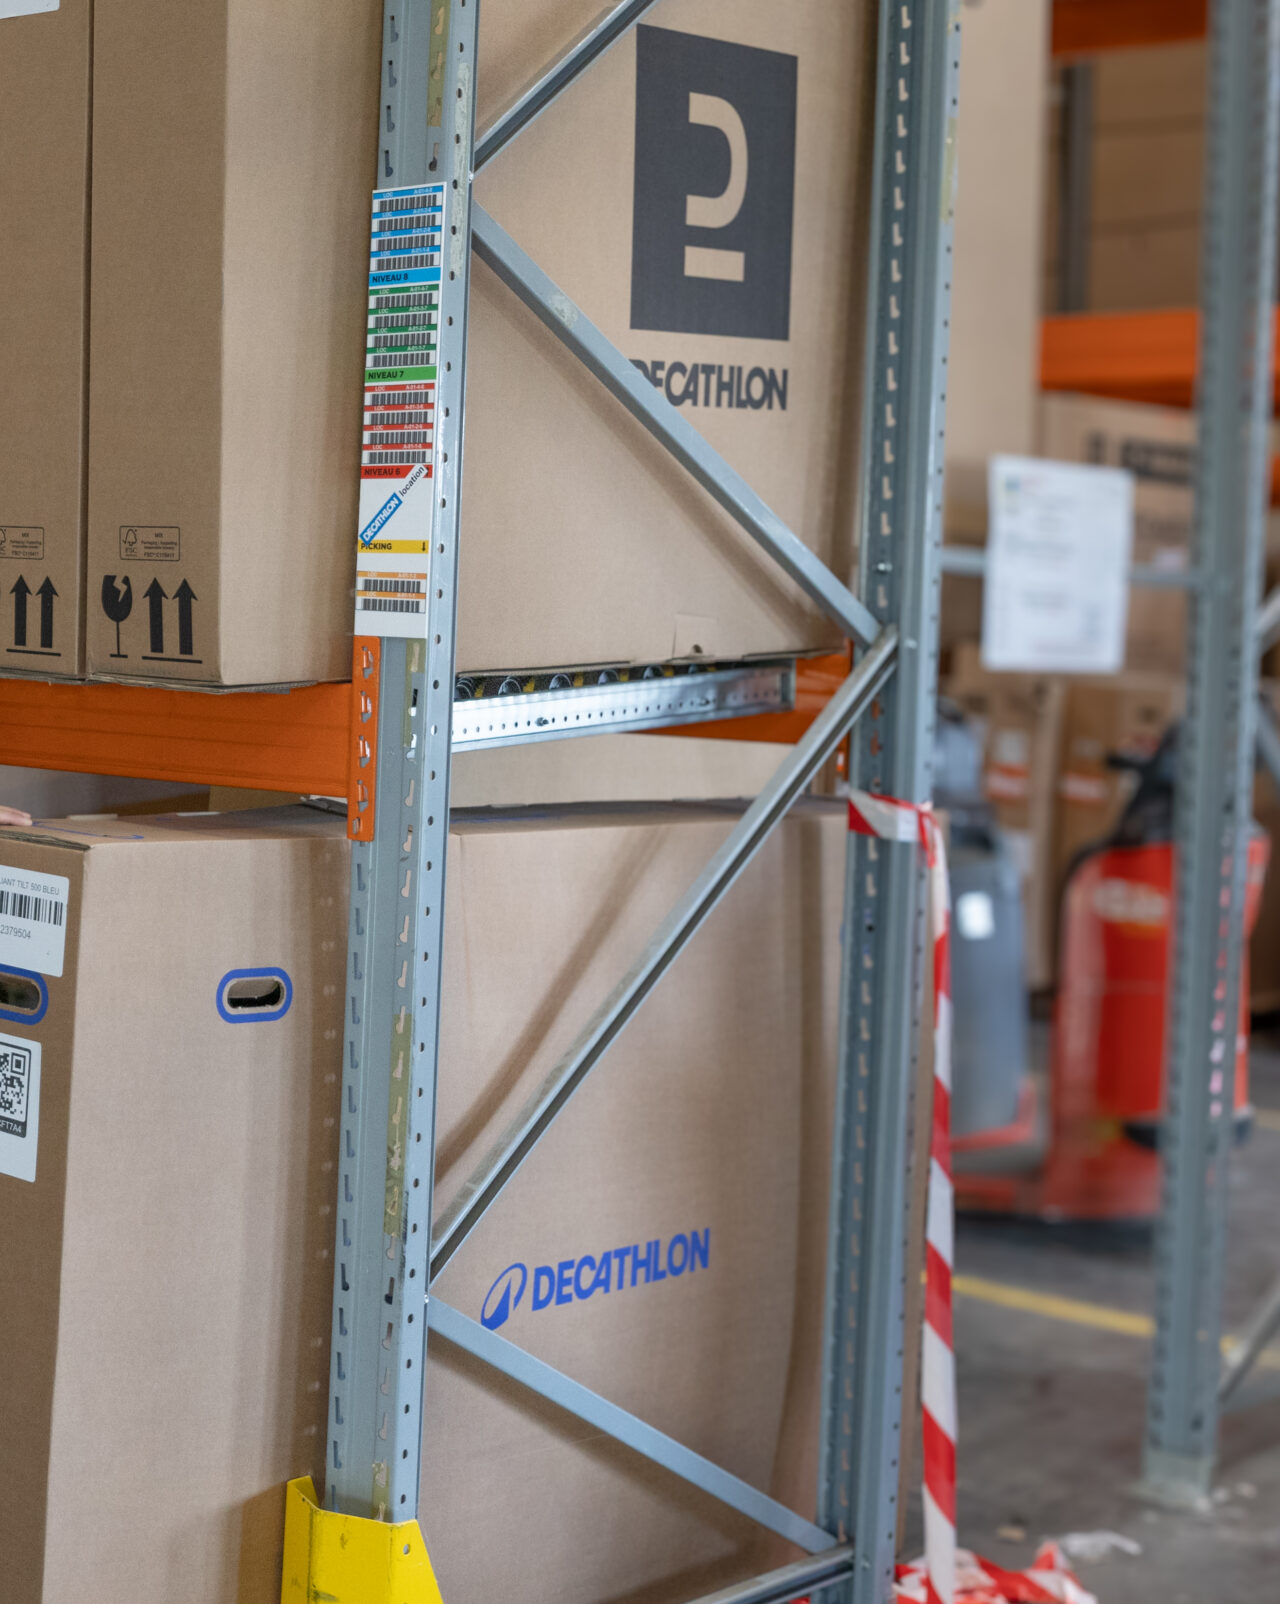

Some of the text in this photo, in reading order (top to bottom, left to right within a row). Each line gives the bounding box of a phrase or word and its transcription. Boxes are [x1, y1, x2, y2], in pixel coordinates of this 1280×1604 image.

[372, 274, 401, 283] NIVEAU
[368, 371, 397, 380] NIVEAU
[362, 466, 425, 542] DECATHLON location
[360, 542, 392, 550] PICKING
[30, 882, 41, 892] 500
[42, 885, 60, 895] BLEU
[0, 924, 31, 939] 2379504
[531, 1227, 710, 1312] DECATHLON
